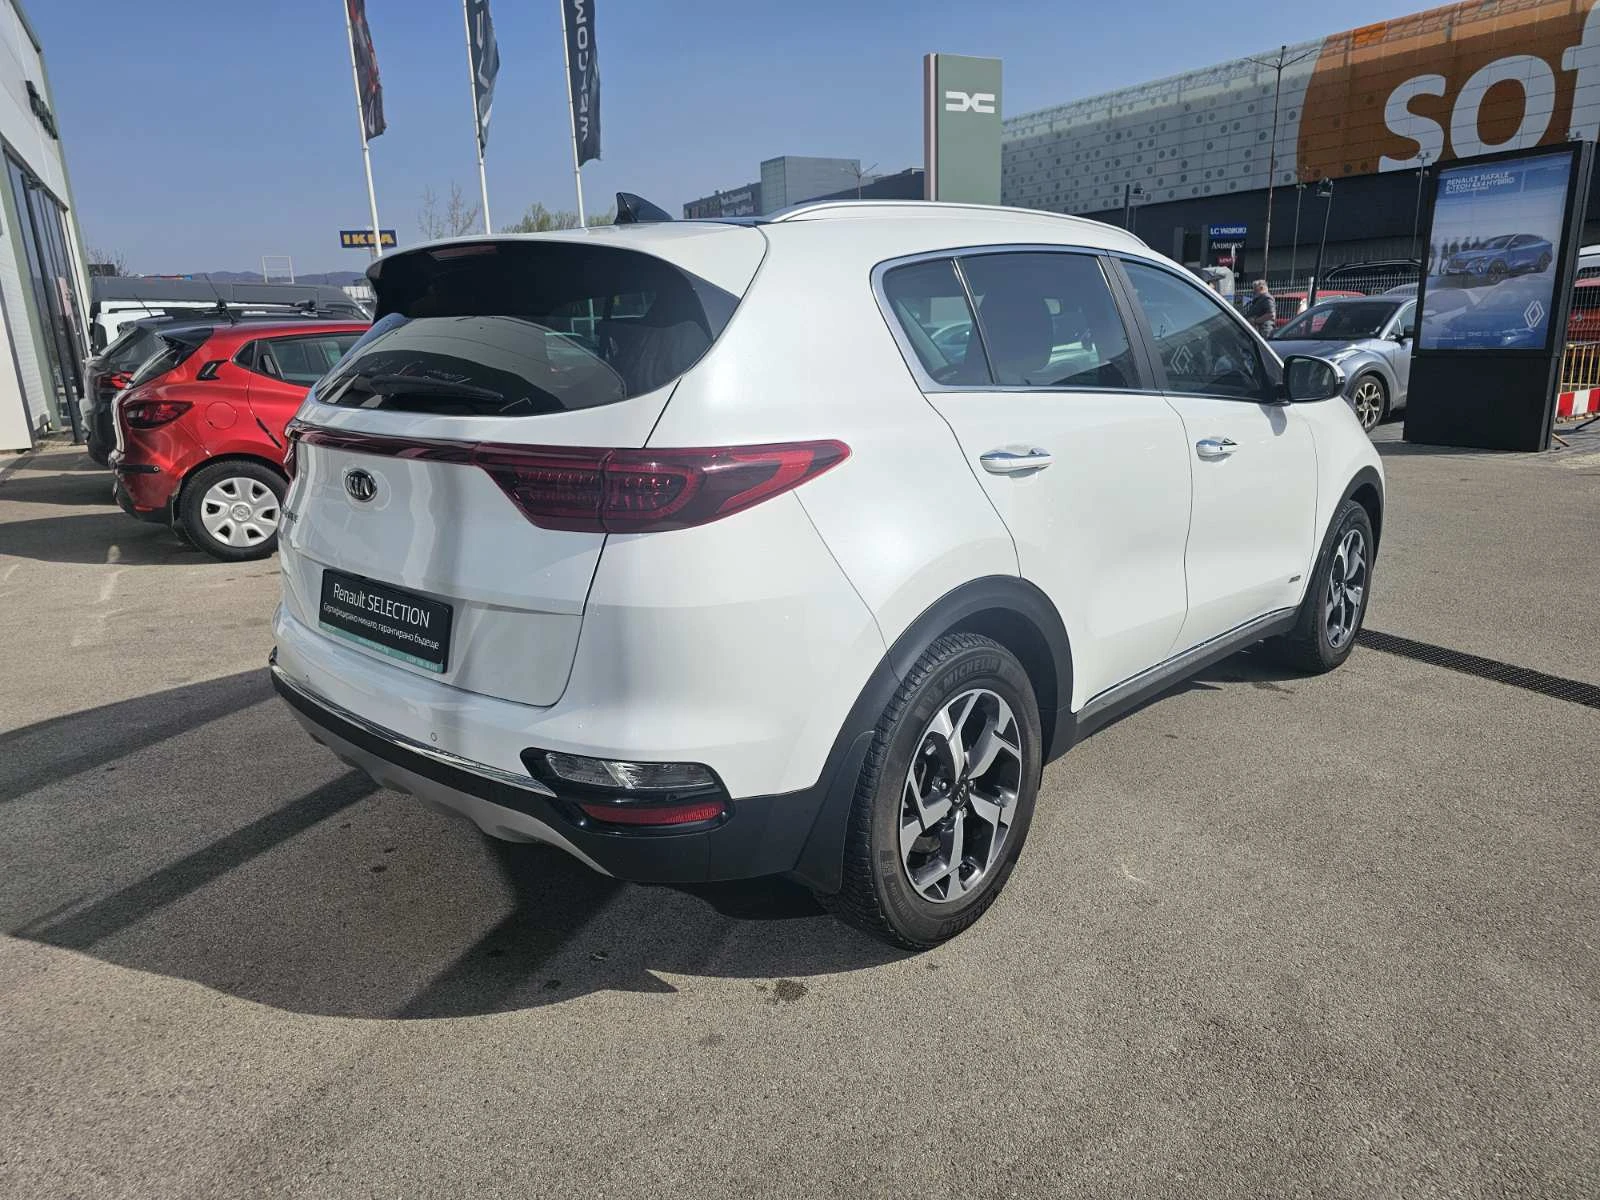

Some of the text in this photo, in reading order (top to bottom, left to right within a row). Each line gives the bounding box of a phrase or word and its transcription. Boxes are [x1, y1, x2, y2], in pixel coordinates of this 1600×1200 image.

[345, 474, 372, 498] KIA
[333, 583, 430, 629] Renault SELECTION
